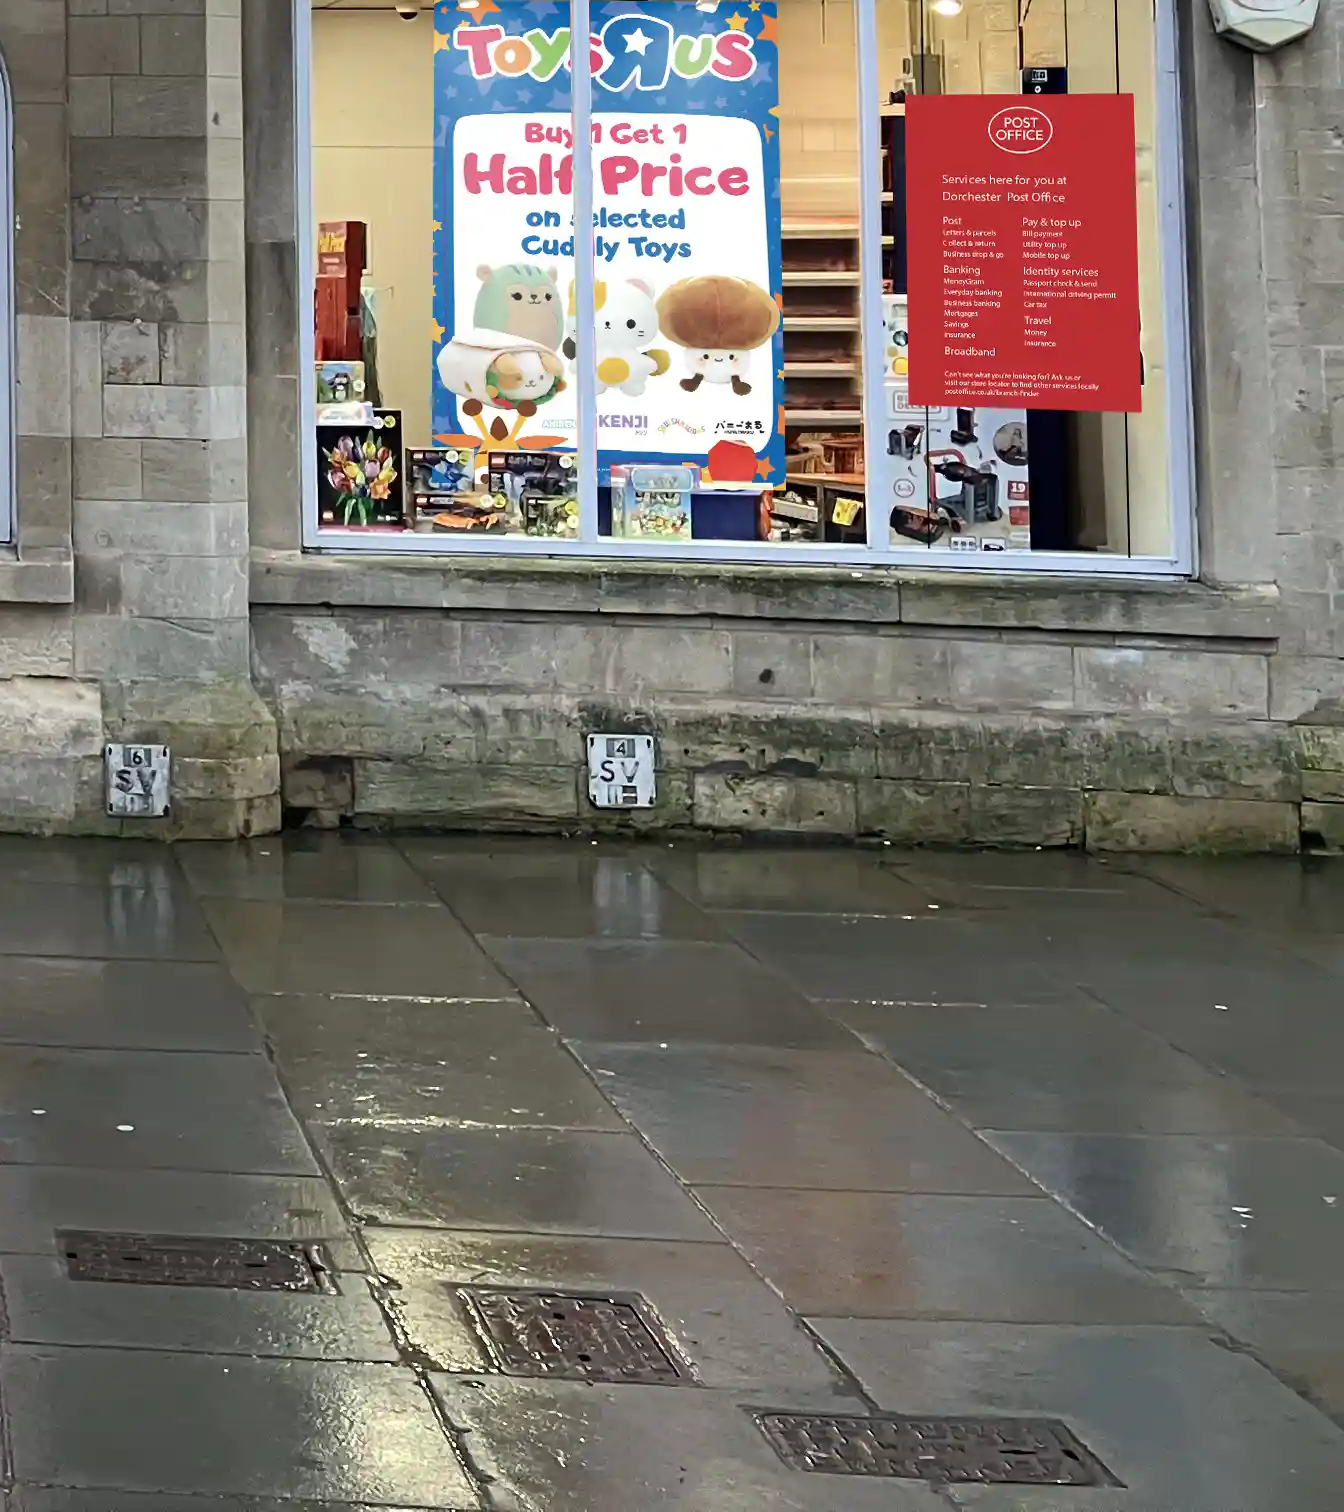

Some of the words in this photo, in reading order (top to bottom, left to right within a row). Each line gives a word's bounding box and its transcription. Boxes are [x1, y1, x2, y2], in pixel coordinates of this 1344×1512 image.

[1004, 117, 1039, 128] POST
[525, 122, 573, 149] Buy
[610, 122, 665, 145] Get
[673, 123, 687, 144] 1
[996, 129, 1043, 141] OFFICE
[463, 152, 573, 196] Half
[600, 152, 750, 197] Price
[942, 175, 987, 185] Services
[989, 175, 1013, 185] here
[1015, 175, 1030, 184] for
[1034, 176, 1055, 187] you
[1057, 176, 1067, 185] at
[942, 191, 1001, 202] Dorchester
[1007, 192, 1029, 202] Post
[1031, 192, 1066, 203] Office
[525, 209, 560, 227] on
[942, 216, 962, 225] Post
[1022, 217, 1038, 228] Pay
[1040, 218, 1048, 227] &
[1050, 219, 1067, 228] top
[1068, 220, 1082, 228] up
[521, 235, 620, 263] Cudly
[628, 236, 692, 264] Toys
[972, 251, 987, 259] drop
[1047, 252, 1059, 260] top
[943, 264, 981, 276] Banking
[1023, 266, 1060, 277] Identity
[1062, 268, 1099, 277] services
[943, 278, 985, 286] MoneyGram
[943, 288, 973, 296] Everyday
[975, 289, 1003, 297] banking
[1094, 292, 1117, 300] permit
[974, 300, 1001, 308] banking
[943, 320, 969, 328] Savings
[1024, 315, 1052, 325] Travel
[1024, 339, 1056, 347] Insurance
[944, 345, 996, 357] Broadband
[1012, 372, 1037, 380] looking
[599, 414, 648, 428] KENJI
[616, 741, 626, 755] 4
[132, 752, 143, 765] 6
[600, 760, 640, 783] SV
